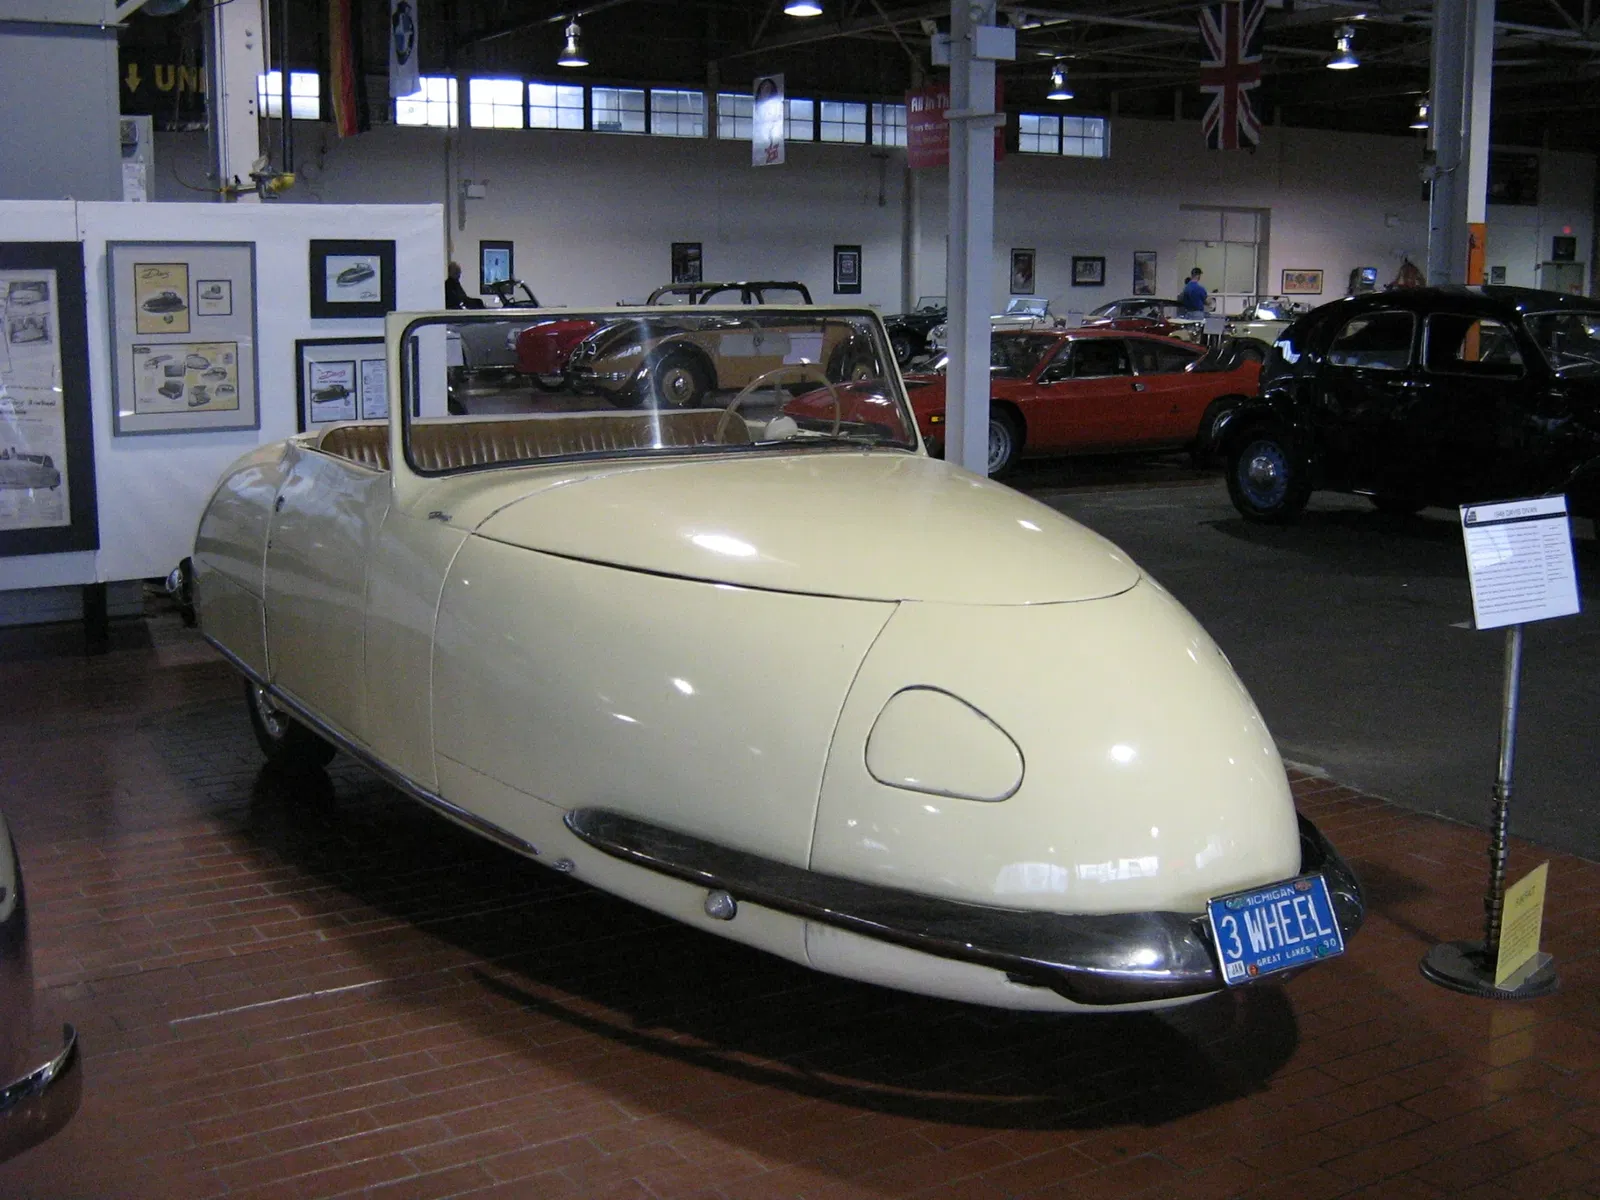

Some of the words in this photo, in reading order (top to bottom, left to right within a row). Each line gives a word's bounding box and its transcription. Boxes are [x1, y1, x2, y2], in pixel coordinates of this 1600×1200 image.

[937, 93, 950, 109] Th
[1221, 915, 1243, 959] 3
[1243, 895, 1332, 954] WHEEL
[1323, 937, 1337, 949] 90
[1256, 953, 1281, 967] GREAT
[1285, 945, 1312, 959] LAKES
[1231, 962, 1244, 976] JAN
